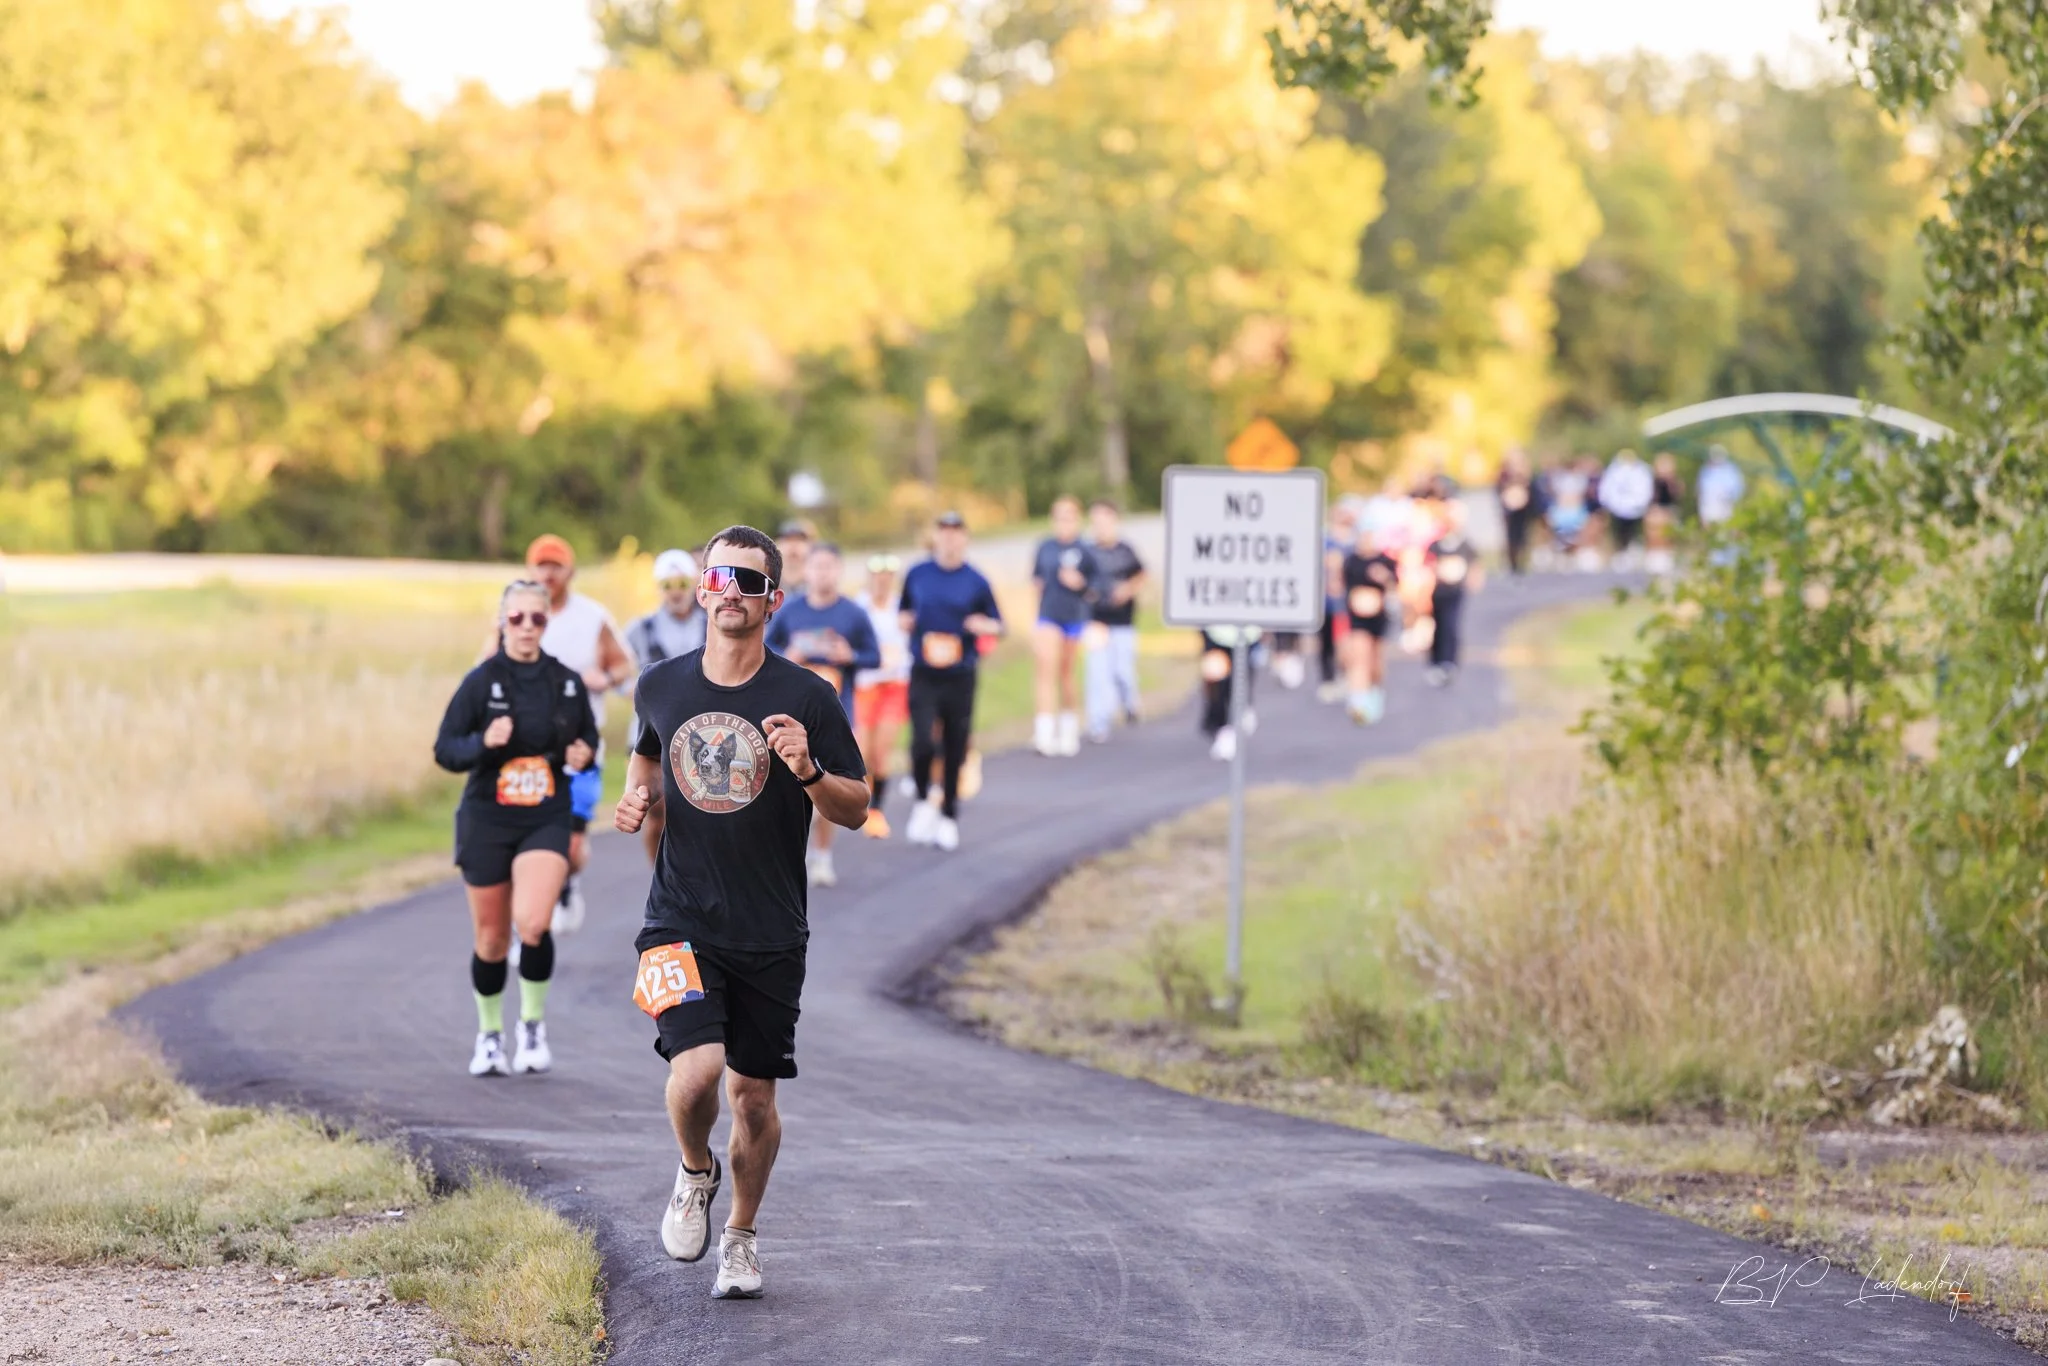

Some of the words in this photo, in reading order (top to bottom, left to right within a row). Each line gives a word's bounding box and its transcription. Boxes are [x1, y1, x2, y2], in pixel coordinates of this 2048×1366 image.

[1224, 490, 1264, 520] NO
[1193, 532, 1293, 563] MOTOR
[1186, 577, 1299, 607] VEHICLES
[673, 721, 698, 748] HAIR
[702, 715, 717, 725] OF
[724, 715, 747, 732] THE
[747, 731, 766, 756] DOG
[503, 767, 547, 796] 205
[701, 797, 734, 810] MILE
[637, 959, 688, 1006] 125
